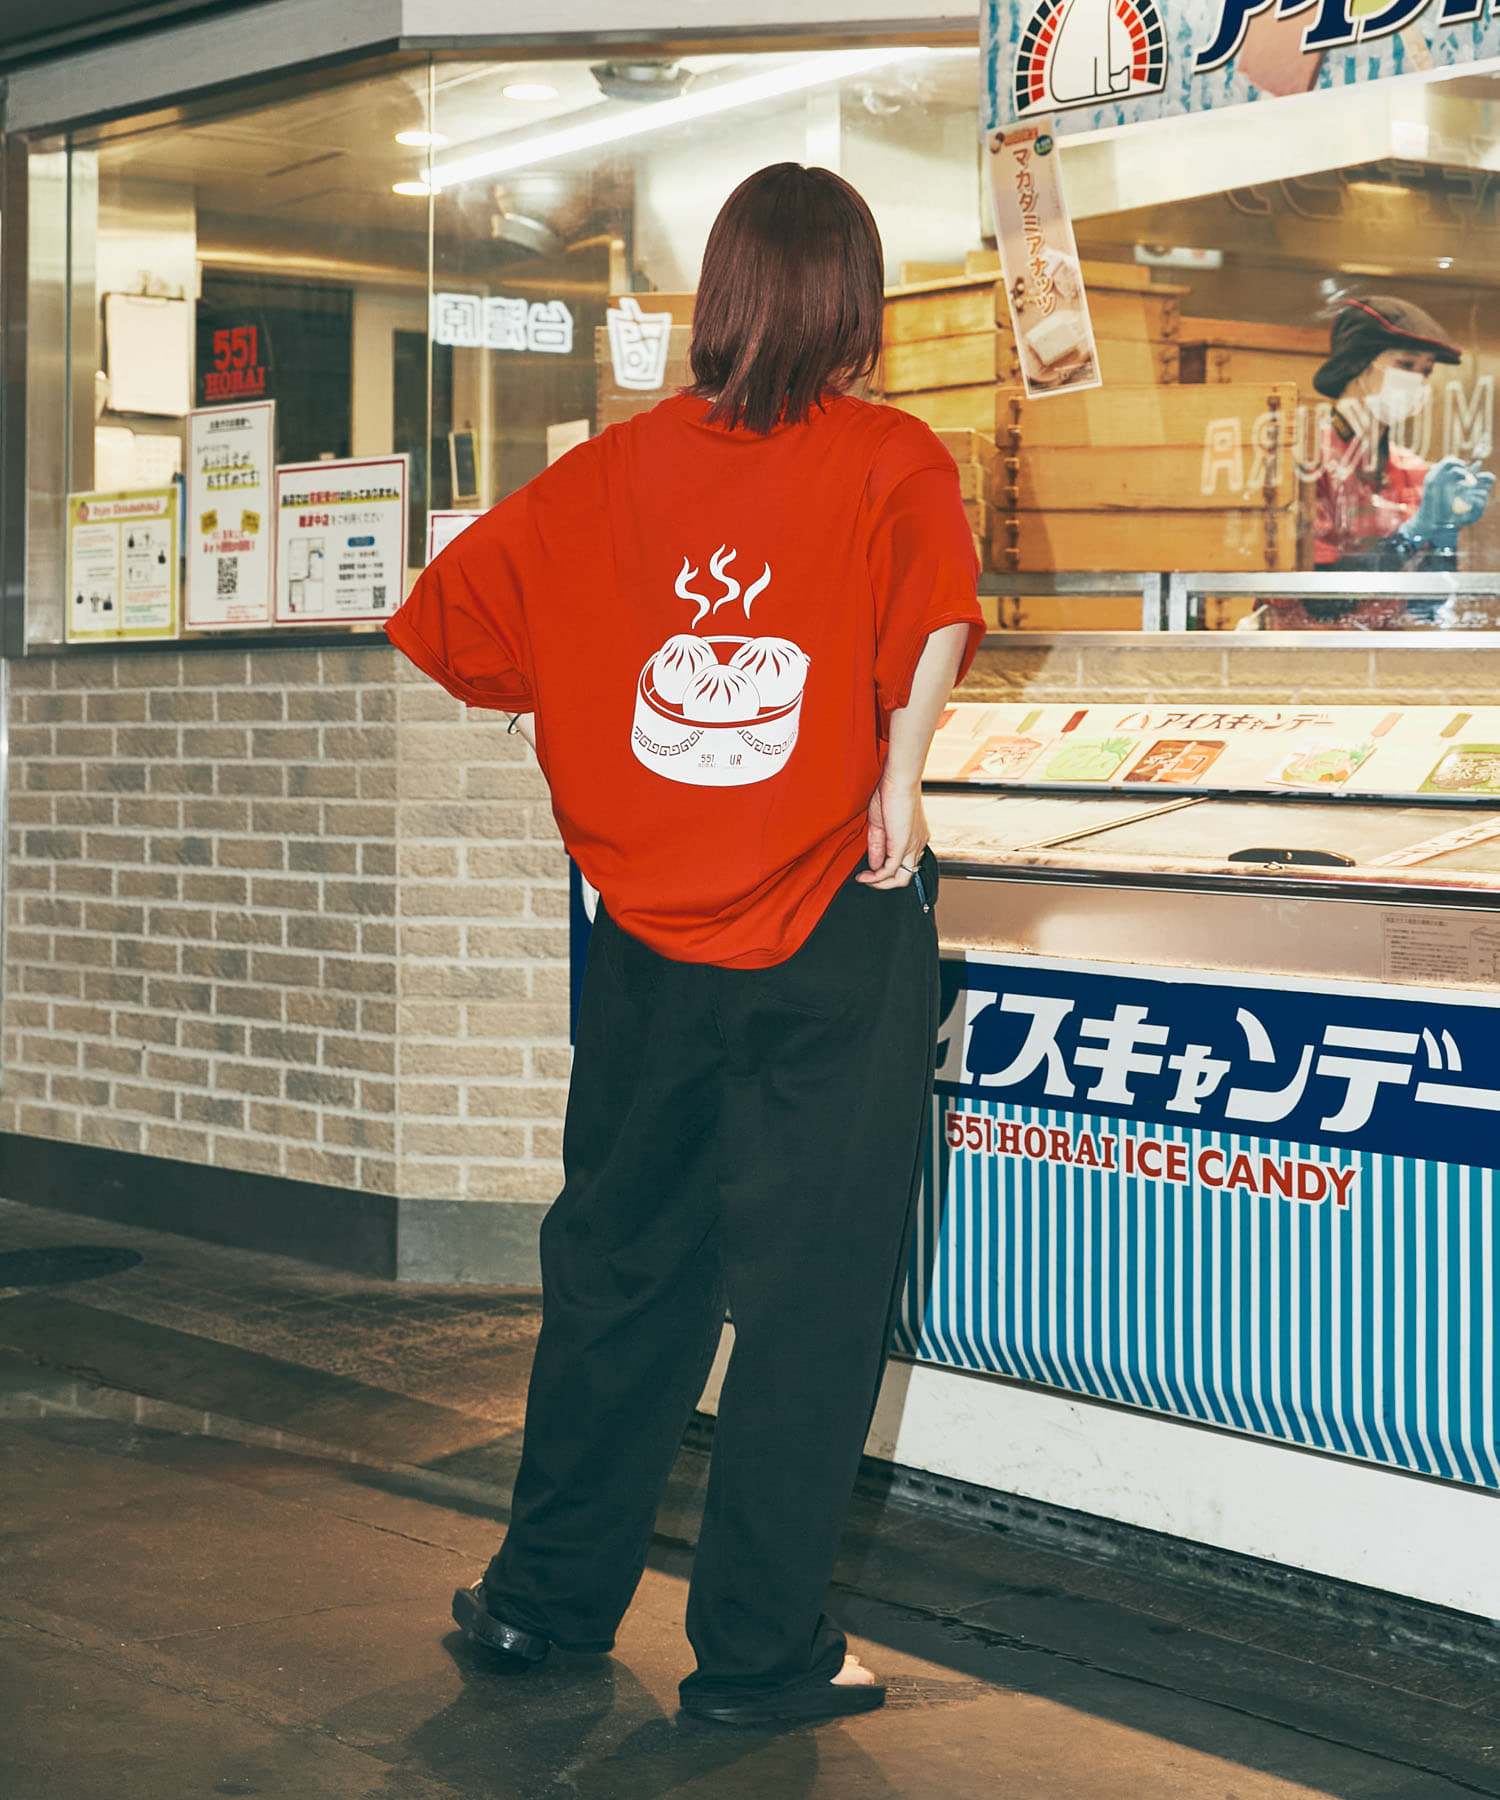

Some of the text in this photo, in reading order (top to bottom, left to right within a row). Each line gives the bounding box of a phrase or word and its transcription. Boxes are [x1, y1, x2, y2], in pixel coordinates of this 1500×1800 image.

[1012, 148, 1054, 314] マカダミアナッツ
[213, 326, 257, 371] 551
[205, 366, 265, 394] HORAI
[1153, 712, 1336, 731] アイスキャンデー
[700, 753, 743, 766] 551 UR
[946, 1112, 1357, 1207] 551 HORAI ICE CANDY
